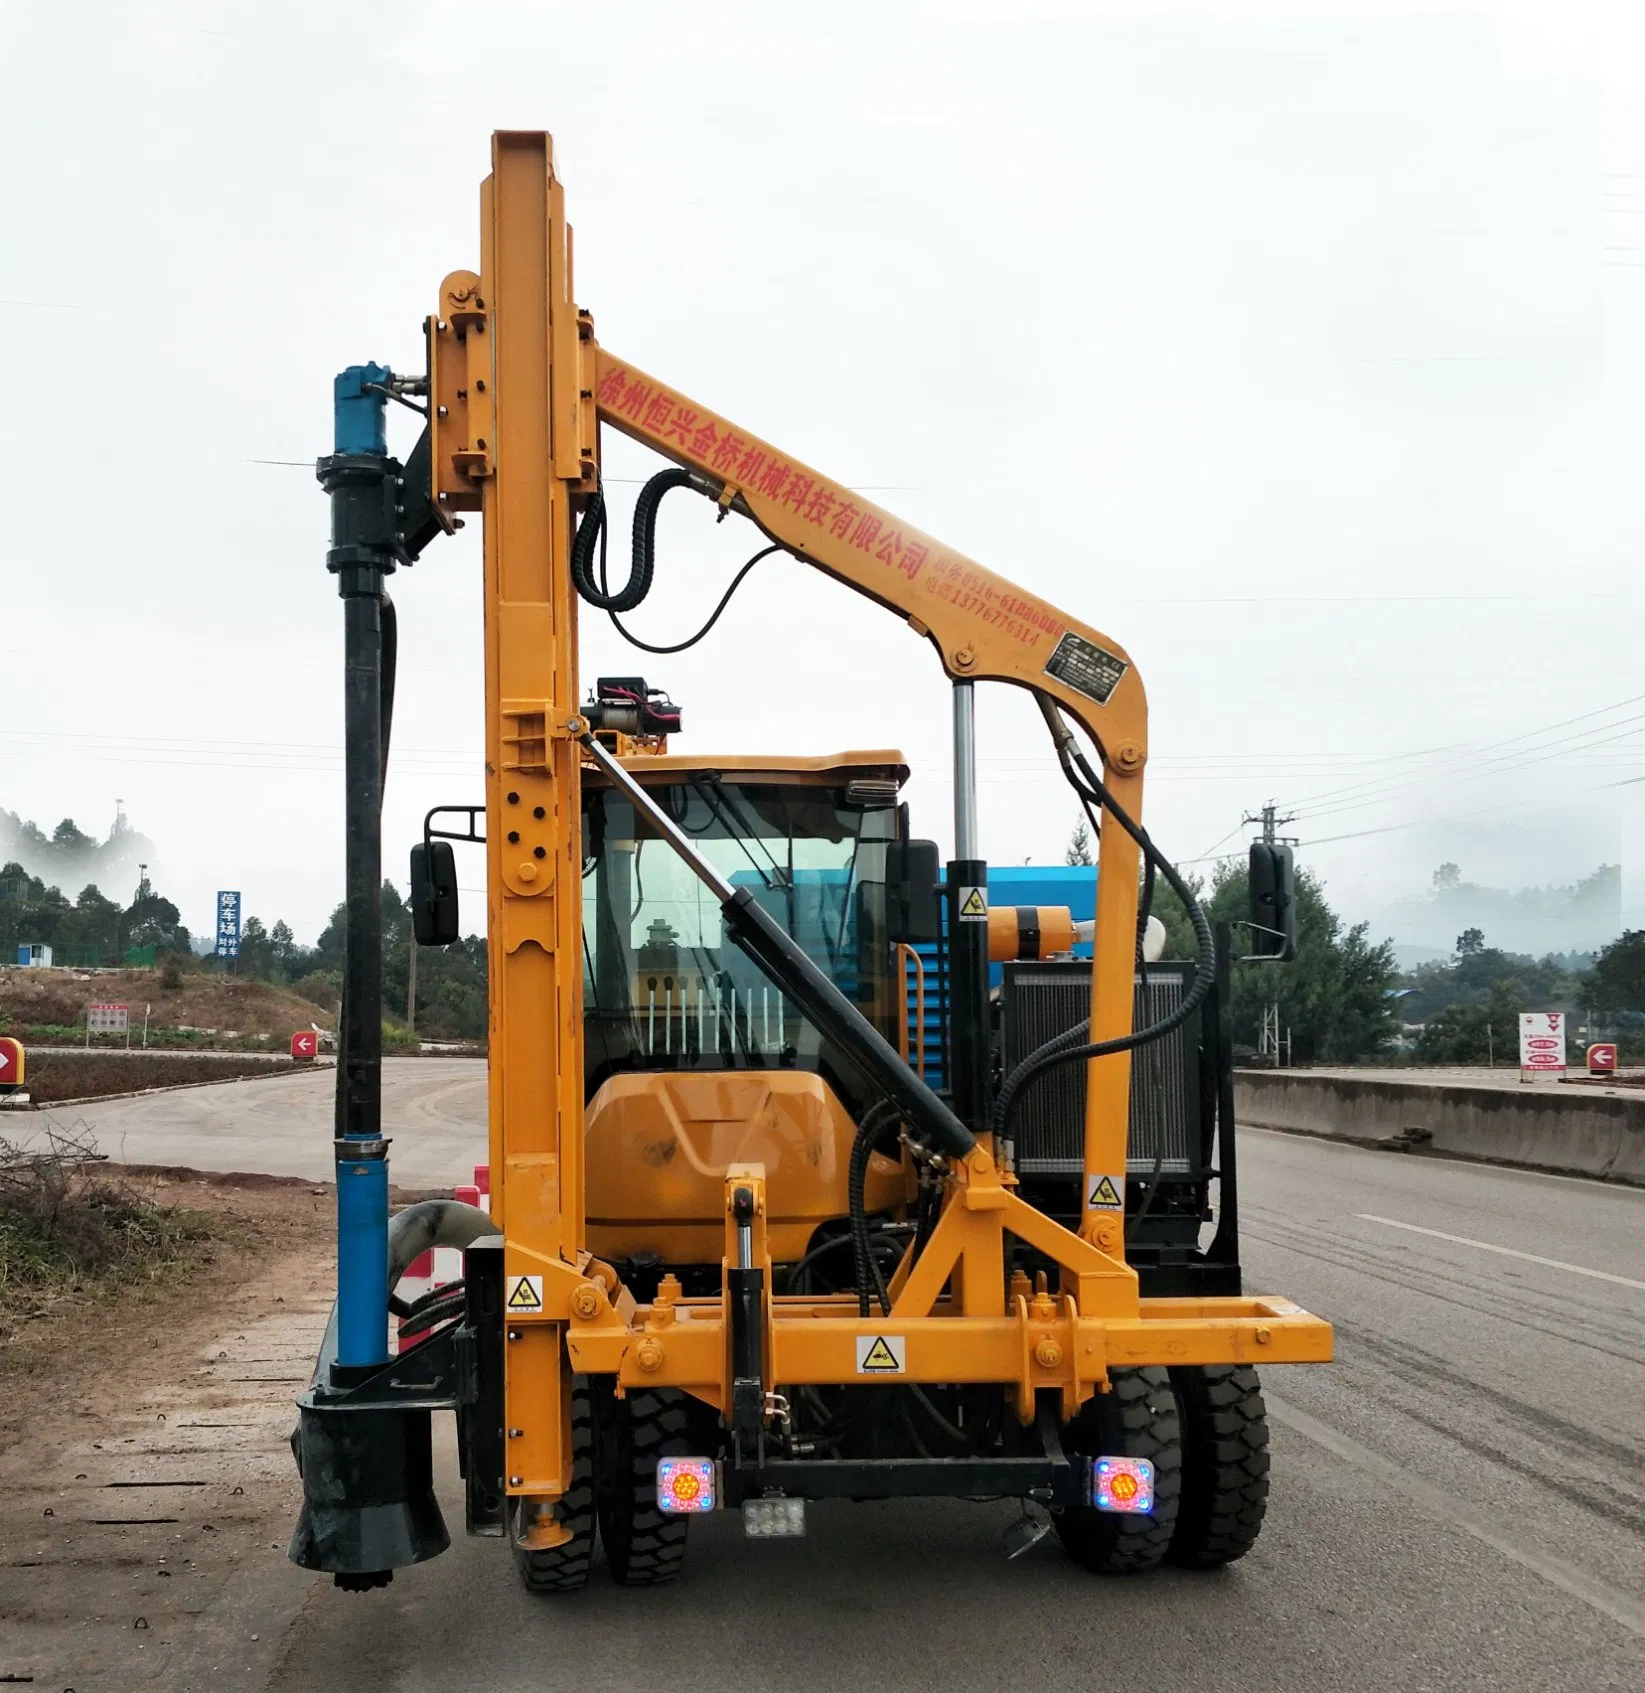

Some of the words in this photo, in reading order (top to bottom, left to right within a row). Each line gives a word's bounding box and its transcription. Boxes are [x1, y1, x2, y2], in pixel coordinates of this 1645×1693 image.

[598, 367, 929, 581] 徐州恒兴金桥机械科技有限公司
[219, 893, 237, 935] 停车场
